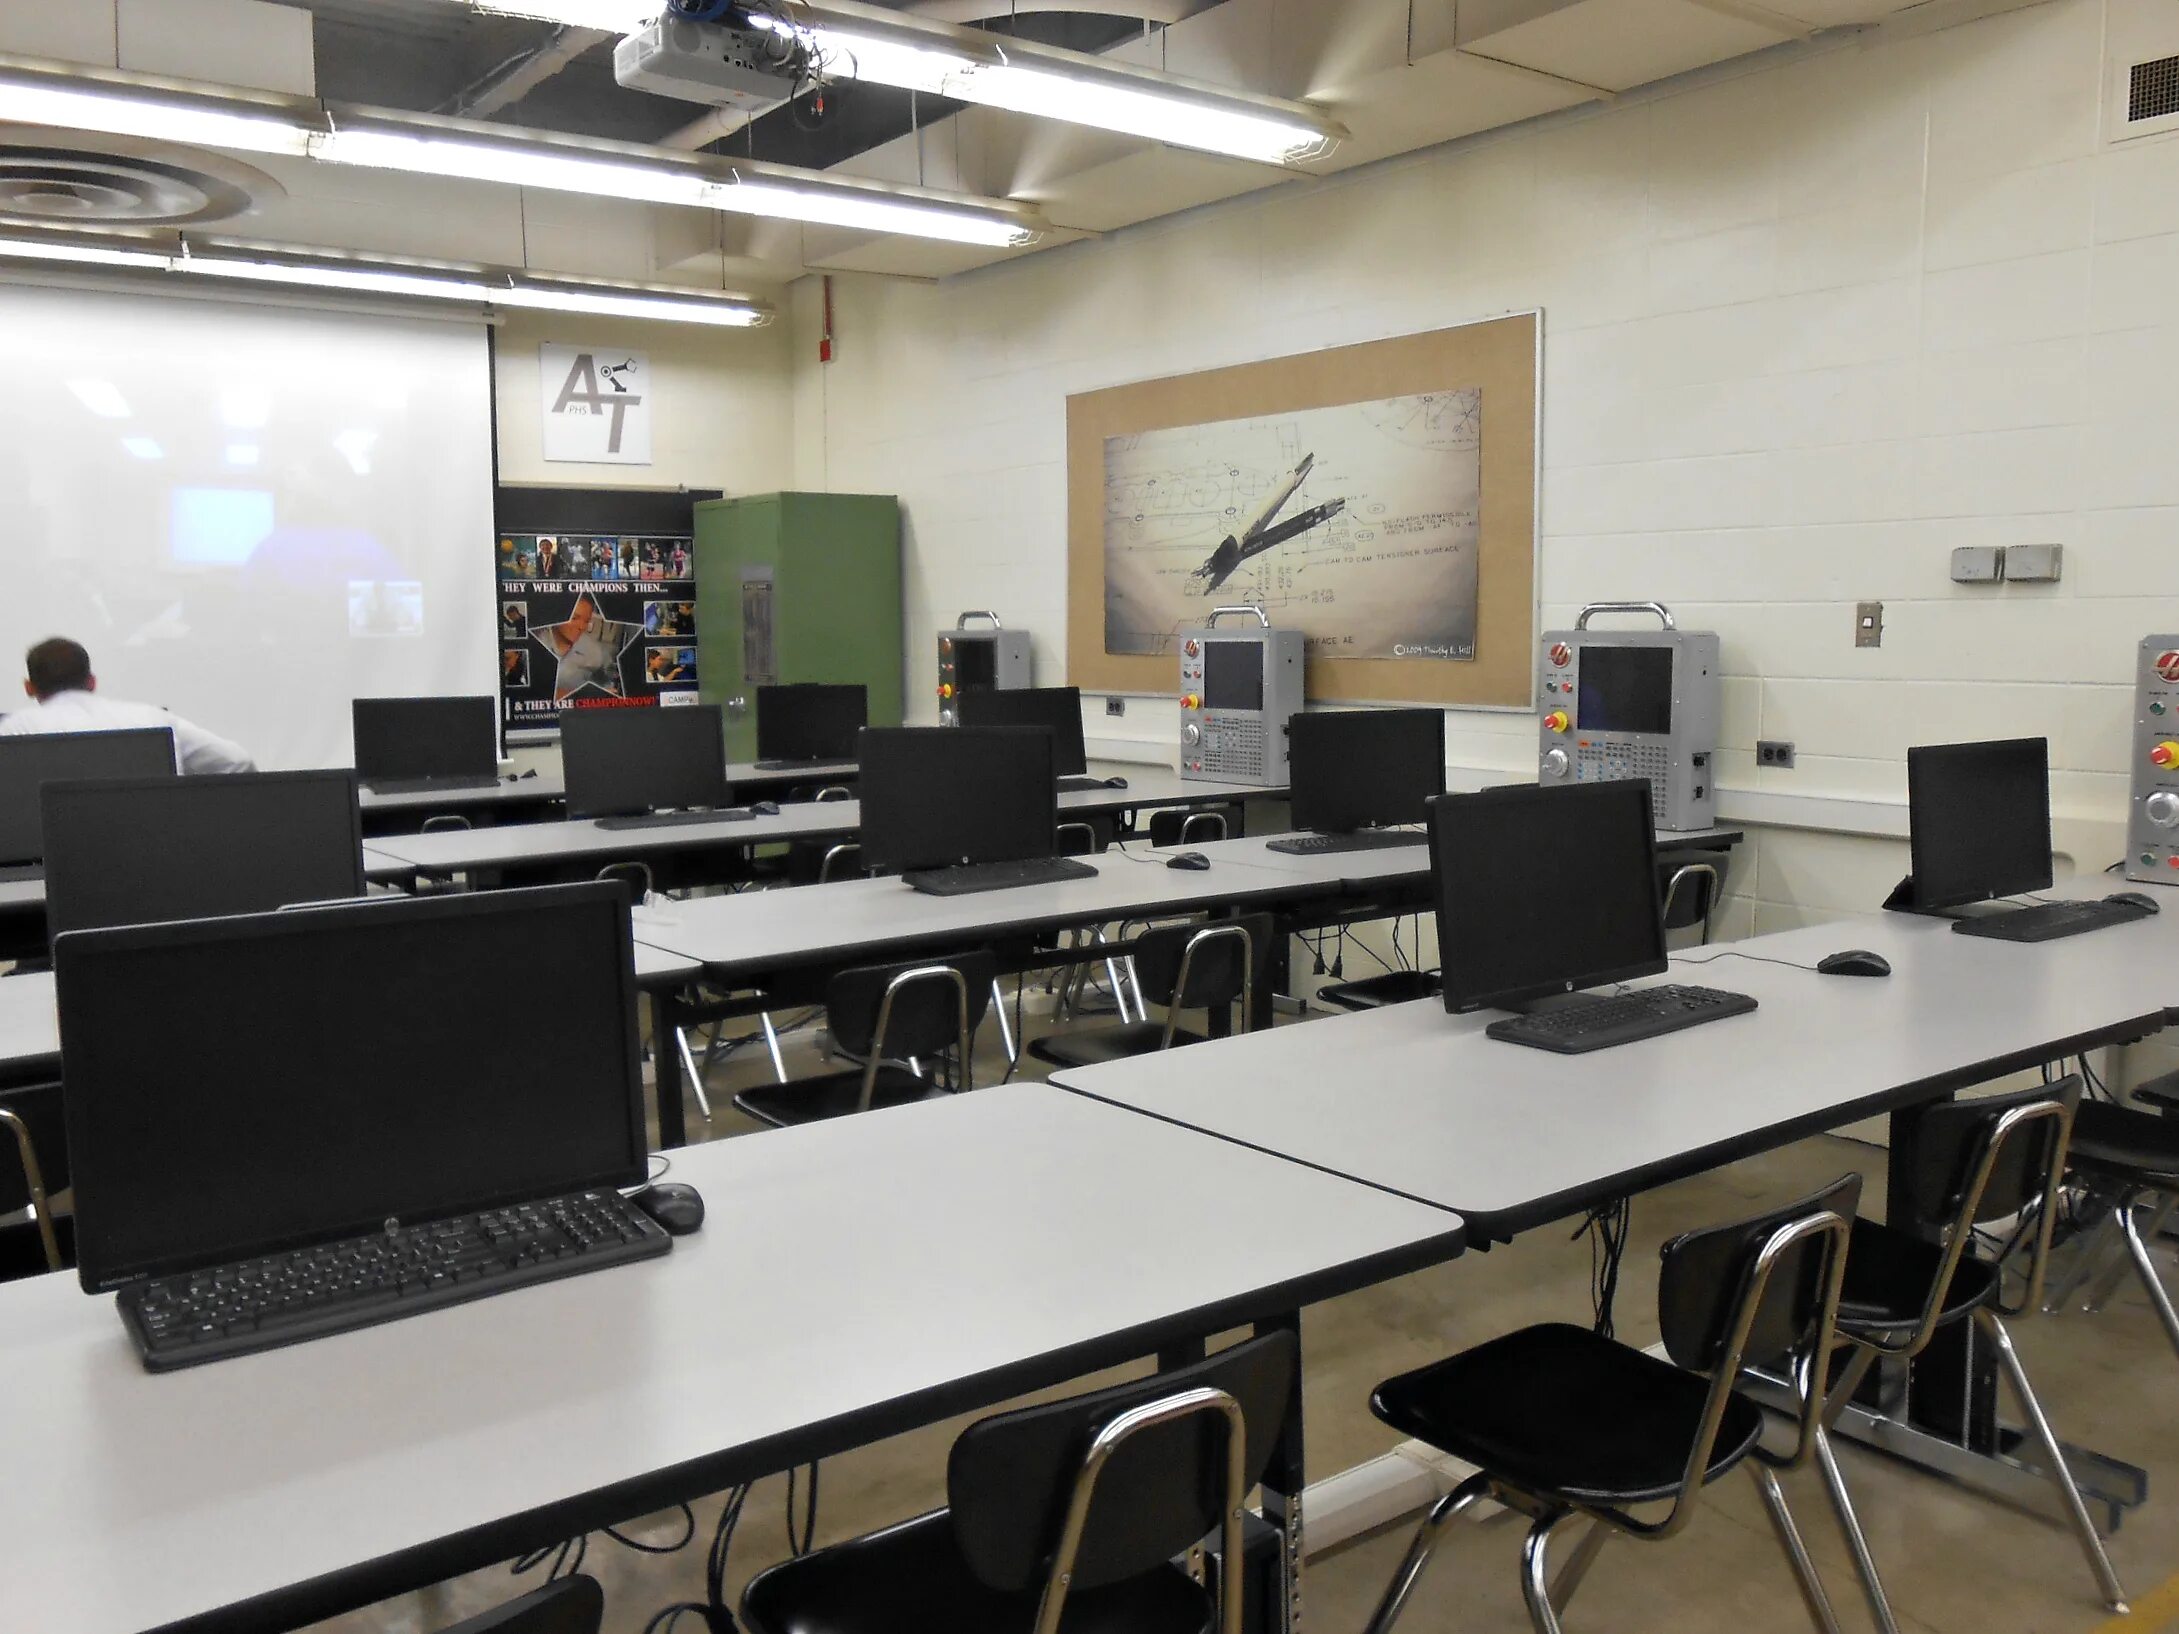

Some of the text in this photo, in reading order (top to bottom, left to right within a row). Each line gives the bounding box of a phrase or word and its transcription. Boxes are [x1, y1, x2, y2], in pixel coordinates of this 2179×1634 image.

[569, 405, 587, 415] PHS
[503, 582, 526, 593] HEY
[533, 582, 563, 593] WERE
[568, 582, 628, 593] CHAMPIONS
[524, 700, 551, 711] THEY
[553, 698, 574, 709] ARE
